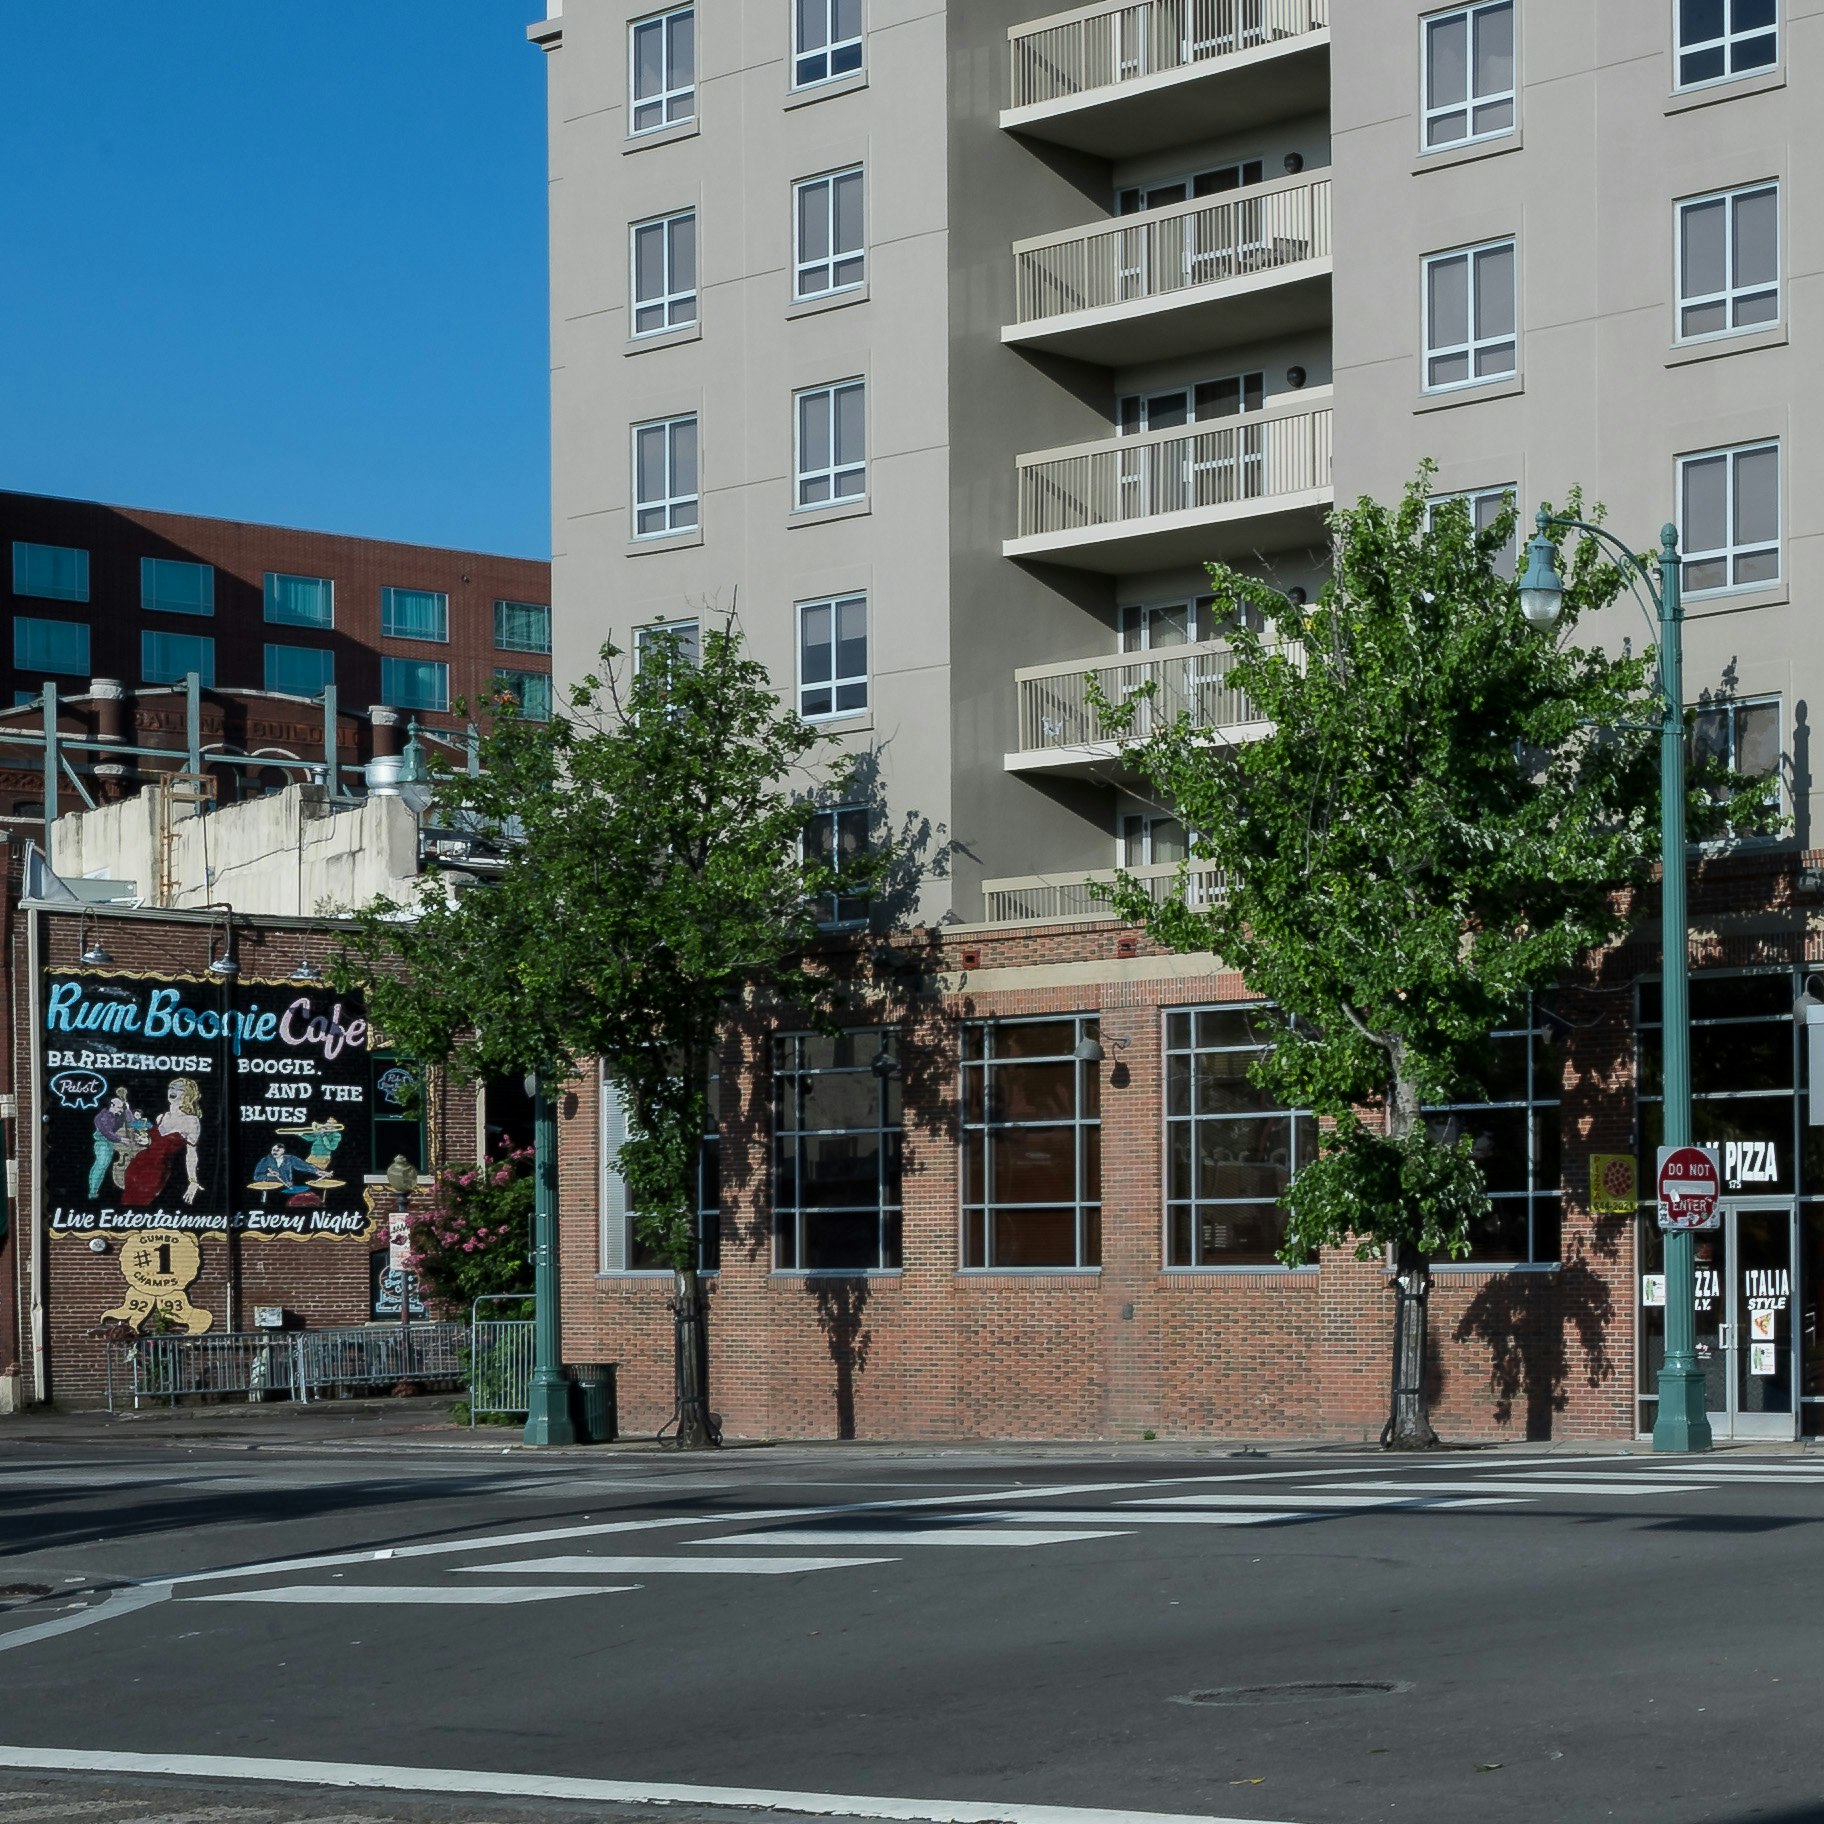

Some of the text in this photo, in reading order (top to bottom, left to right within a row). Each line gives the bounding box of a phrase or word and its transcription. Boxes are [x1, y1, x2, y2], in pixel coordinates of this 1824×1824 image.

[132, 709, 363, 747] GALLNA BUILDNG
[48, 981, 367, 1060] Rum Boogie Cafe
[47, 1049, 322, 1076] BARRELHOUSE BOOGIE.
[60, 1079, 100, 1094] Pabst
[264, 1082, 312, 1099] AND
[321, 1084, 364, 1102] THE
[240, 1105, 307, 1123] BLUES
[1668, 1163, 1710, 1177] DO NOT
[1725, 1141, 1778, 1182] PIZZA
[1593, 1155, 1601, 1200] PIZZA
[1672, 1198, 1707, 1212] ENTER
[53, 1207, 95, 1229] Live
[248, 1210, 305, 1233] Every
[310, 1210, 365, 1234] Night
[139, 1234, 180, 1245] GUMBO
[133, 1243, 175, 1275] #1
[132, 1271, 179, 1288] CHAMPS
[1694, 1270, 1720, 1297] ZZA
[1745, 1268, 1790, 1297] ITALIA
[128, 1299, 149, 1313] 92
[1747, 1296, 1787, 1310] STYLE
